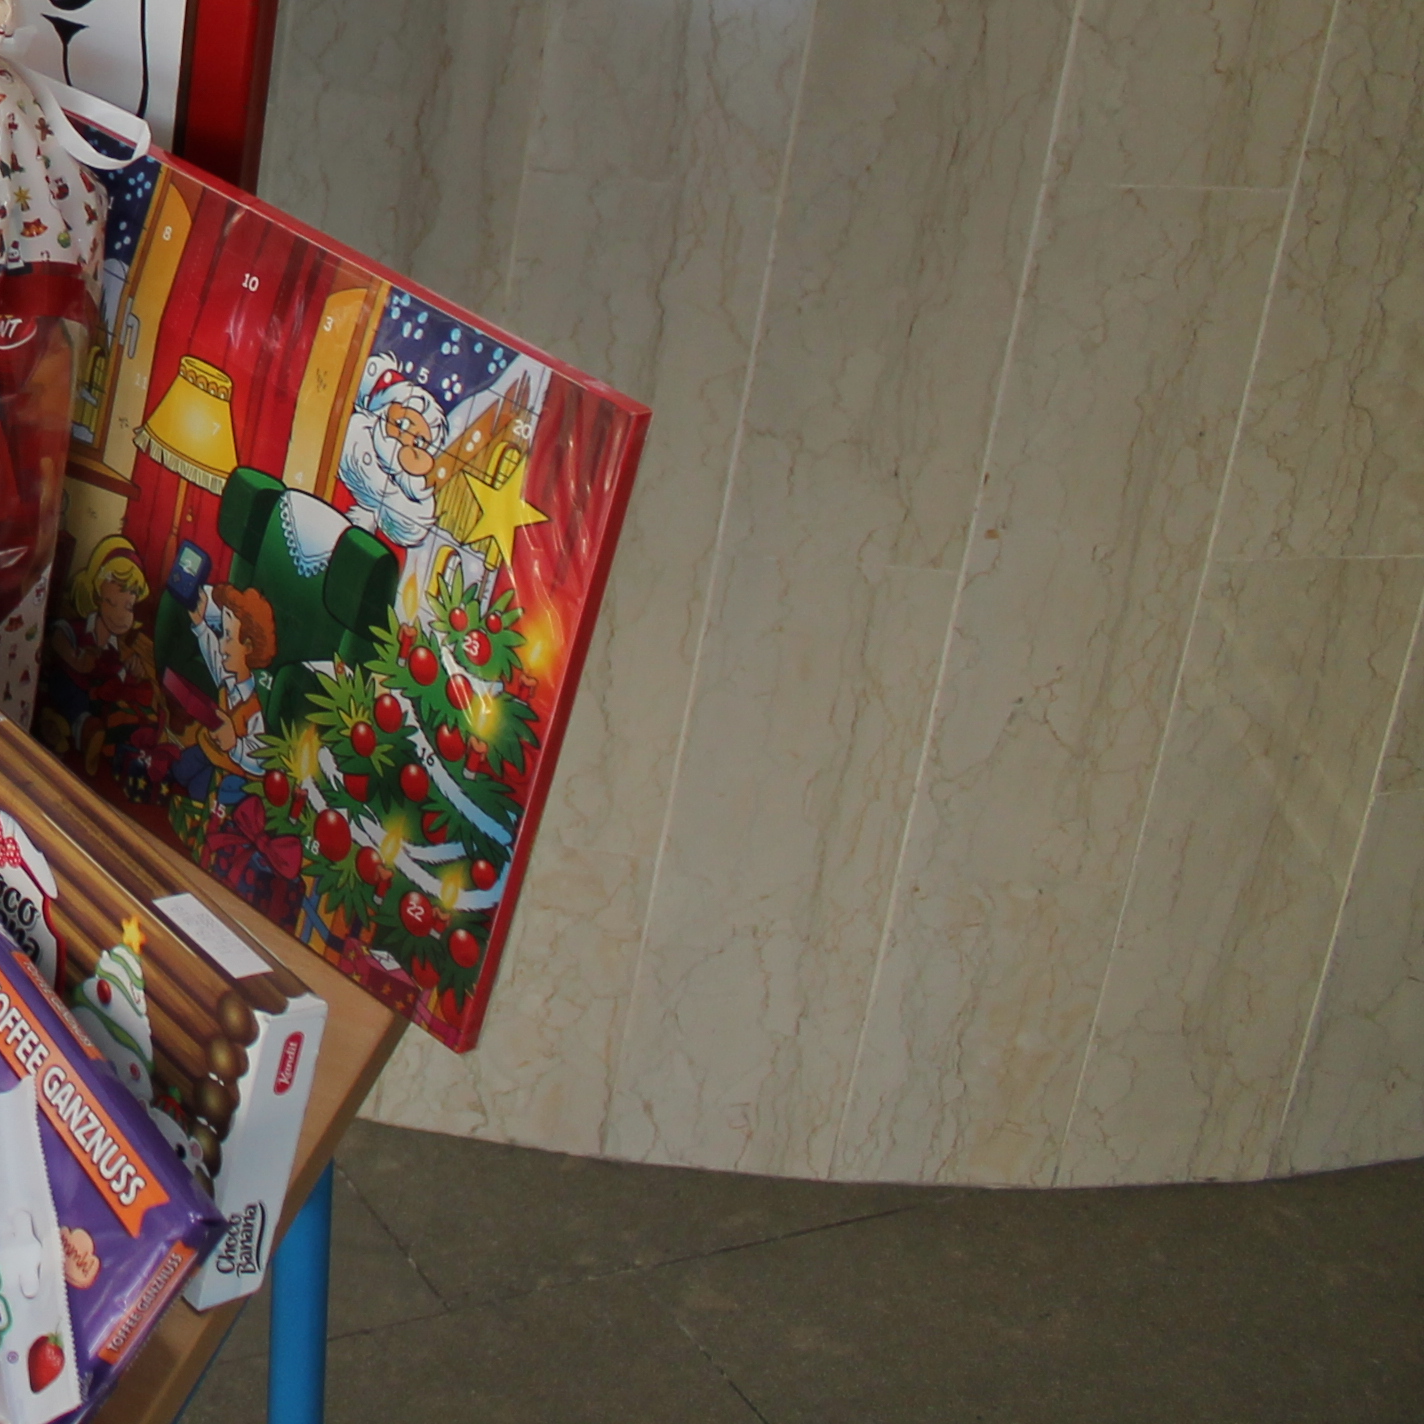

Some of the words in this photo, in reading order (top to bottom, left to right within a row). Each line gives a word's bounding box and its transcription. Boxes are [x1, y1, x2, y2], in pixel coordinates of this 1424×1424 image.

[241, 273, 260, 293] 10
[461, 636, 480, 657] 23
[406, 902, 425, 923] 22
[278, 1038, 302, 1087] Kandit
[41, 1066, 148, 1207] GANZNUSS
[216, 1211, 243, 1277] Choco
[235, 1204, 259, 1278] Banana
[107, 1307, 141, 1356] TOFFEE
[139, 1251, 184, 1311] GANZNUSS
